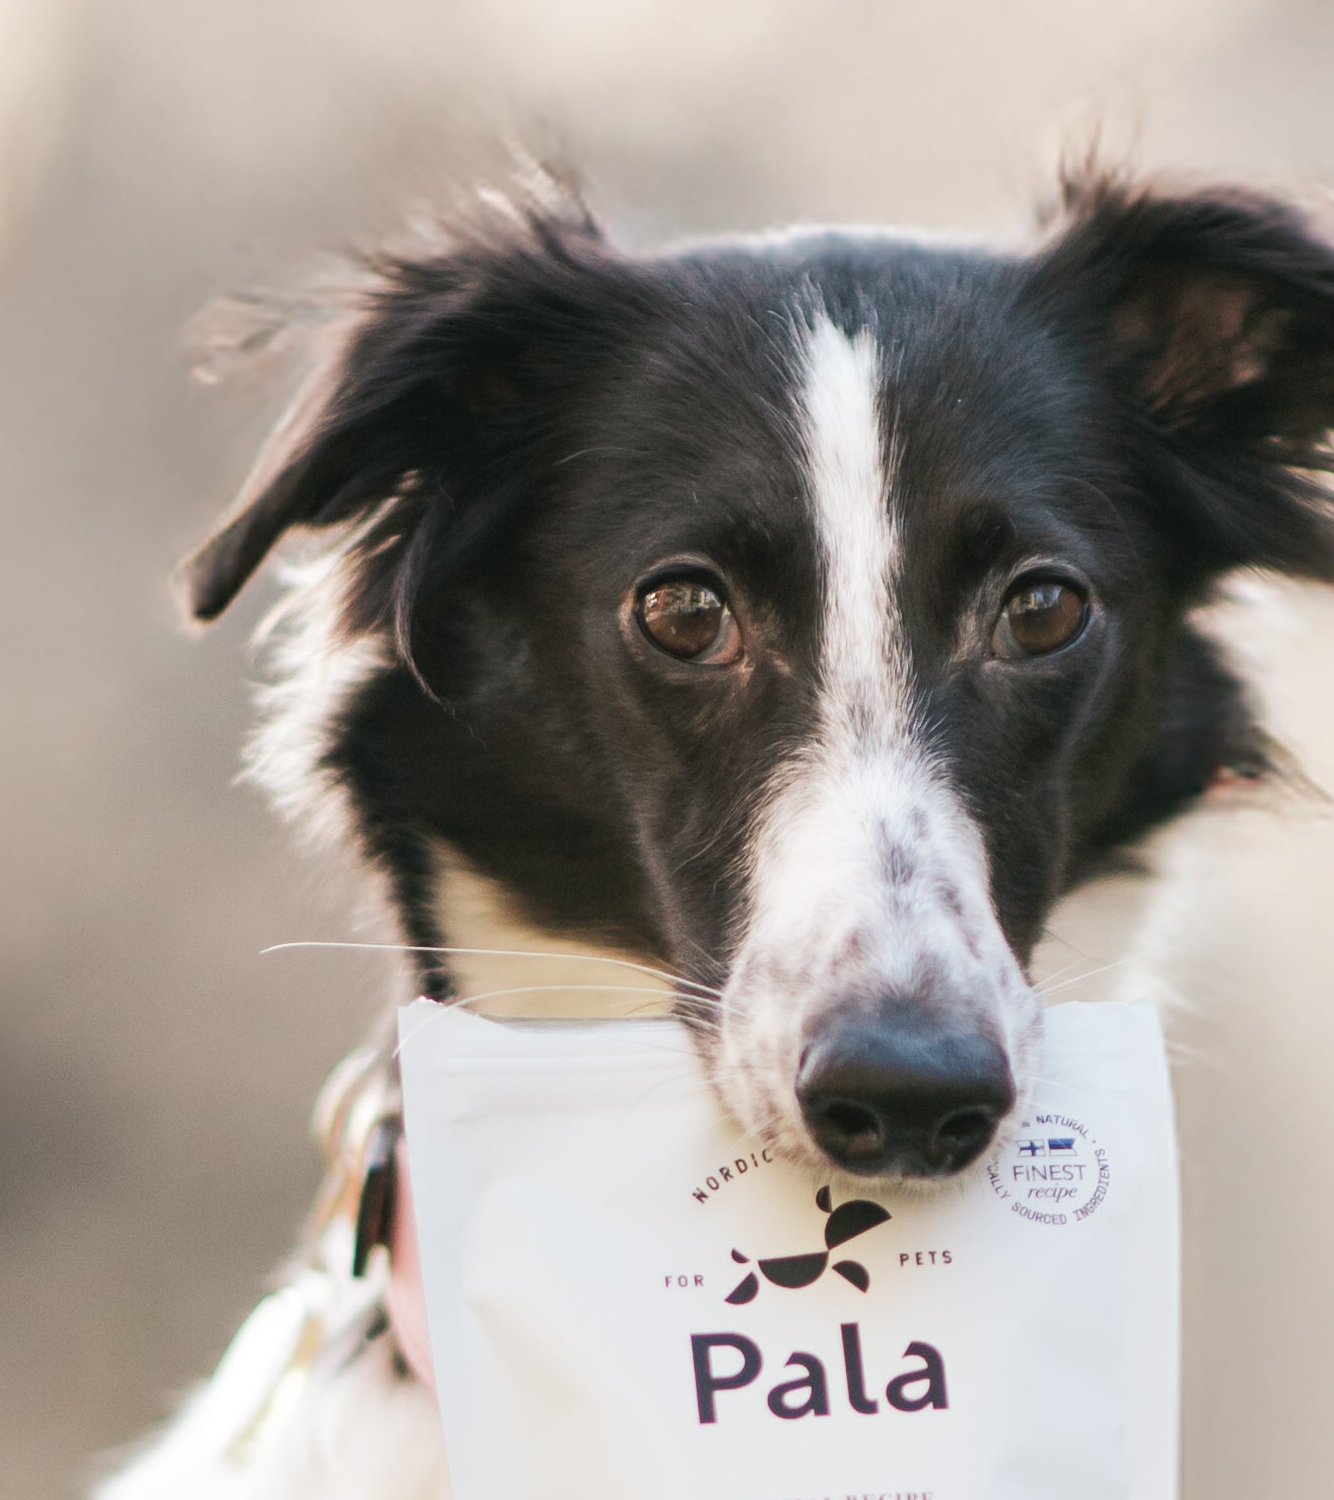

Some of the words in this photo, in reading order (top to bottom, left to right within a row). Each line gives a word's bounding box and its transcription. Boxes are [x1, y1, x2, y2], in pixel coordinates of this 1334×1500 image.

[1036, 1114, 1091, 1139] NATURAL
[692, 1148, 773, 1204] NORDIC
[986, 1156, 1011, 1199] CALLY
[1011, 1202, 1067, 1225] SOURCED
[1072, 1148, 1110, 1222] INGREDIENTS
[1012, 1164, 1086, 1181] FINEST
[1027, 1182, 1078, 1203] recipe
[665, 1274, 704, 1288] FOR
[899, 1250, 953, 1267] PETS
[690, 1322, 950, 1424] Pala
